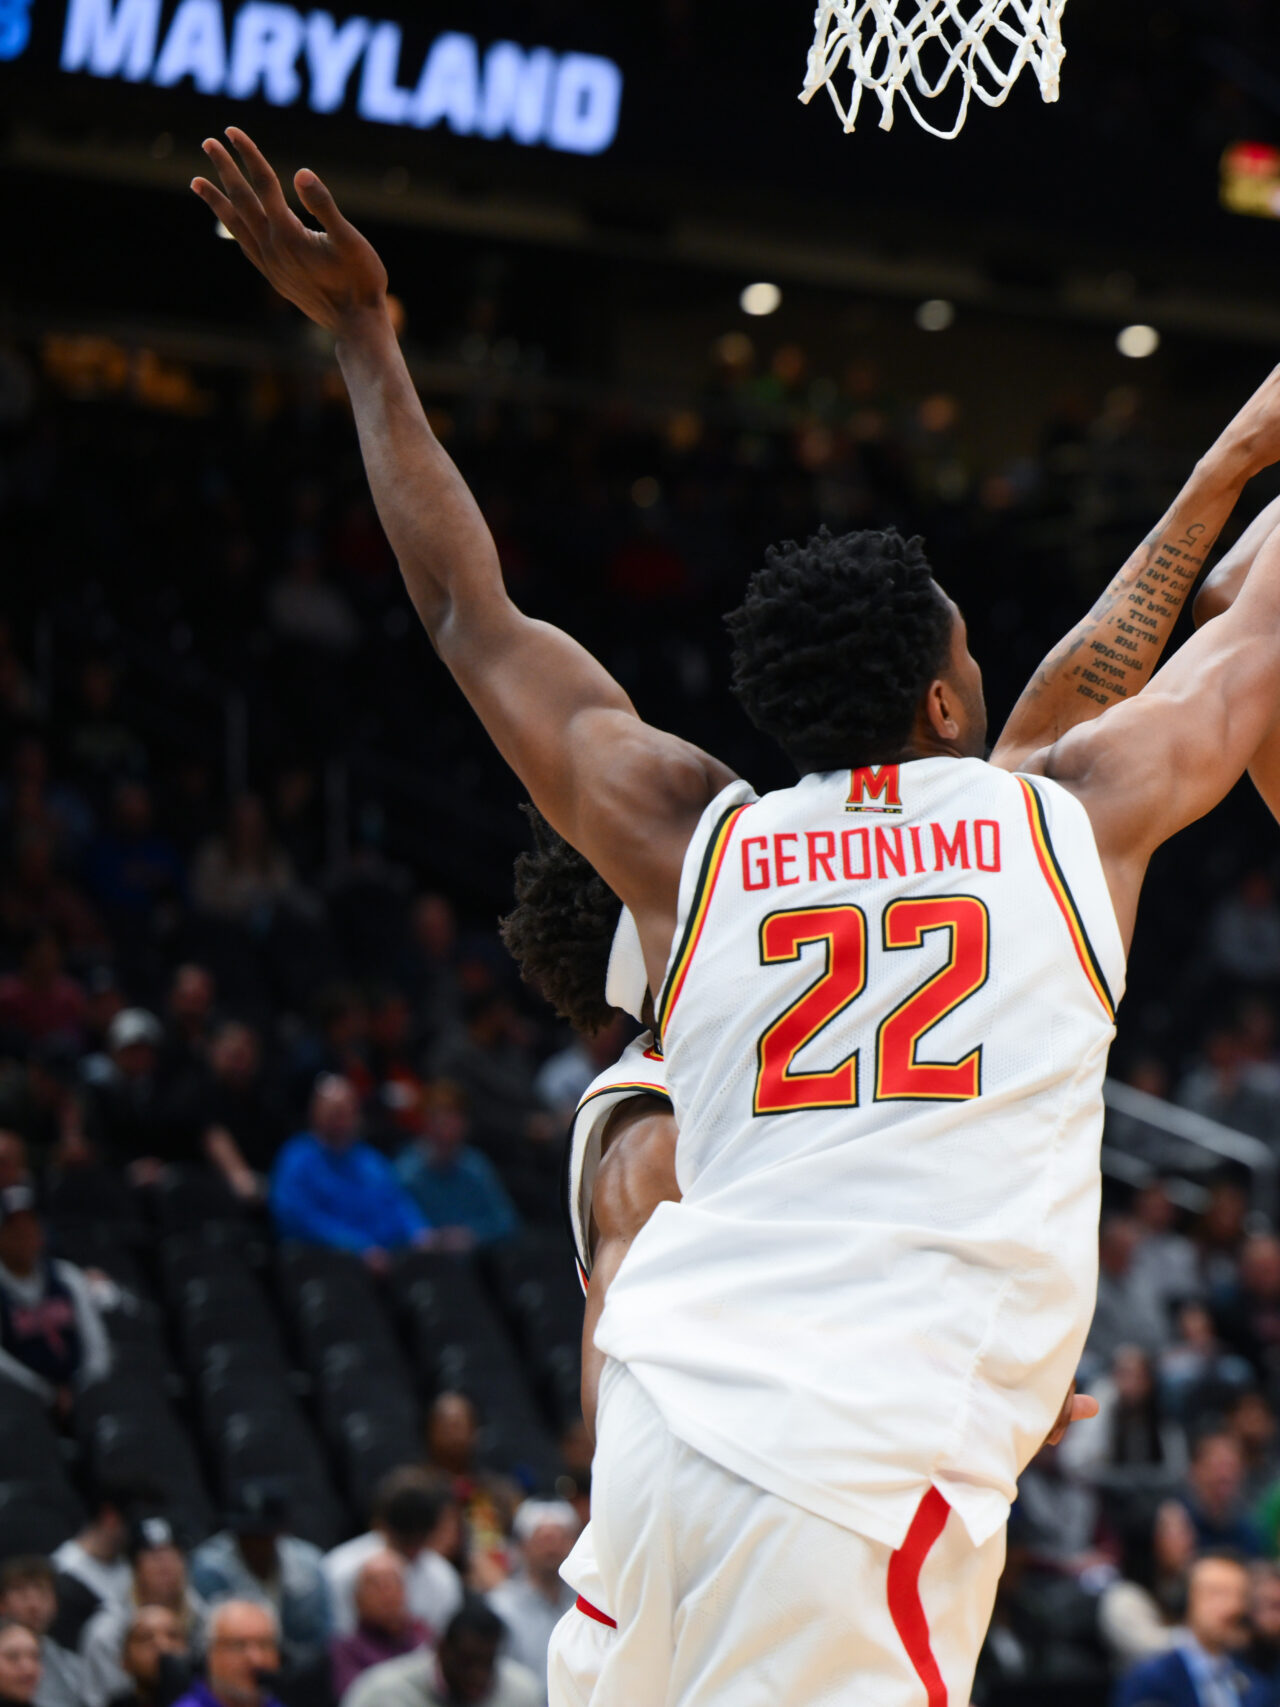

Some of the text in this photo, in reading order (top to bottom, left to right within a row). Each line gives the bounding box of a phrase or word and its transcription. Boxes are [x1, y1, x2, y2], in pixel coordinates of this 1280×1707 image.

[60, 0, 622, 154] MARYLAND
[1178, 523, 1206, 547] 5
[1155, 556, 1172, 569] ME
[1146, 568, 1169, 583] ARE
[1135, 580, 1156, 596] FOR
[1127, 593, 1146, 606] NO
[1129, 608, 1158, 629] WILL
[1114, 635, 1139, 652] THE
[1090, 640, 1143, 671] THROUGH
[1091, 658, 1126, 679] WALK
[1081, 668, 1127, 697] THOUGH
[1077, 684, 1110, 705] EVEN
[846, 763, 902, 805] M
[741, 819, 1001, 891] GERONIMO
[752, 894, 990, 1118] 22
